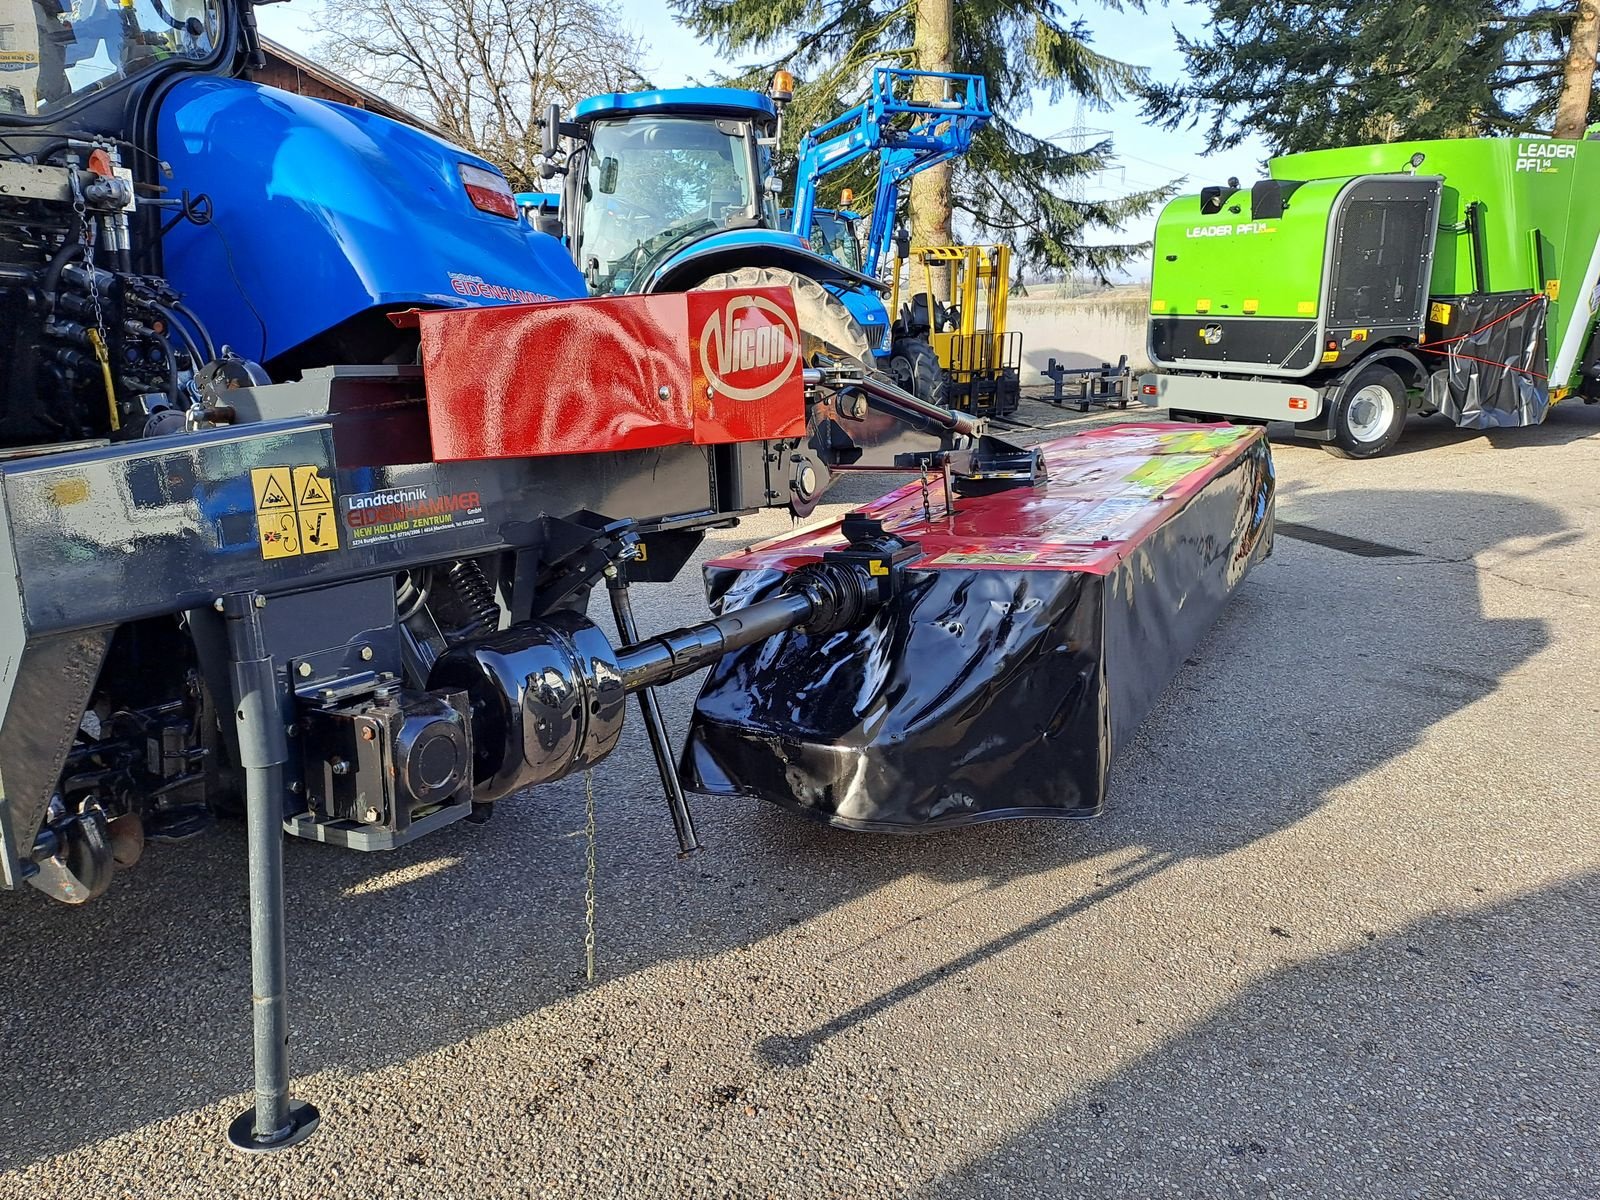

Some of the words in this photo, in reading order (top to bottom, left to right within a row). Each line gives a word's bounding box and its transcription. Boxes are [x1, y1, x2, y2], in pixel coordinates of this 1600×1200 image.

[1518, 143, 1576, 158] LEADER
[1186, 225, 1233, 238] LEADER
[711, 297, 786, 376] Vicon
[349, 488, 428, 509] Landtechnik
[347, 491, 481, 528] EIDENHAMMER
[466, 507, 482, 515] GmbH
[353, 526, 373, 538] NEW
[373, 520, 410, 535] HOLLAND
[412, 513, 453, 529] ZENTRUM
